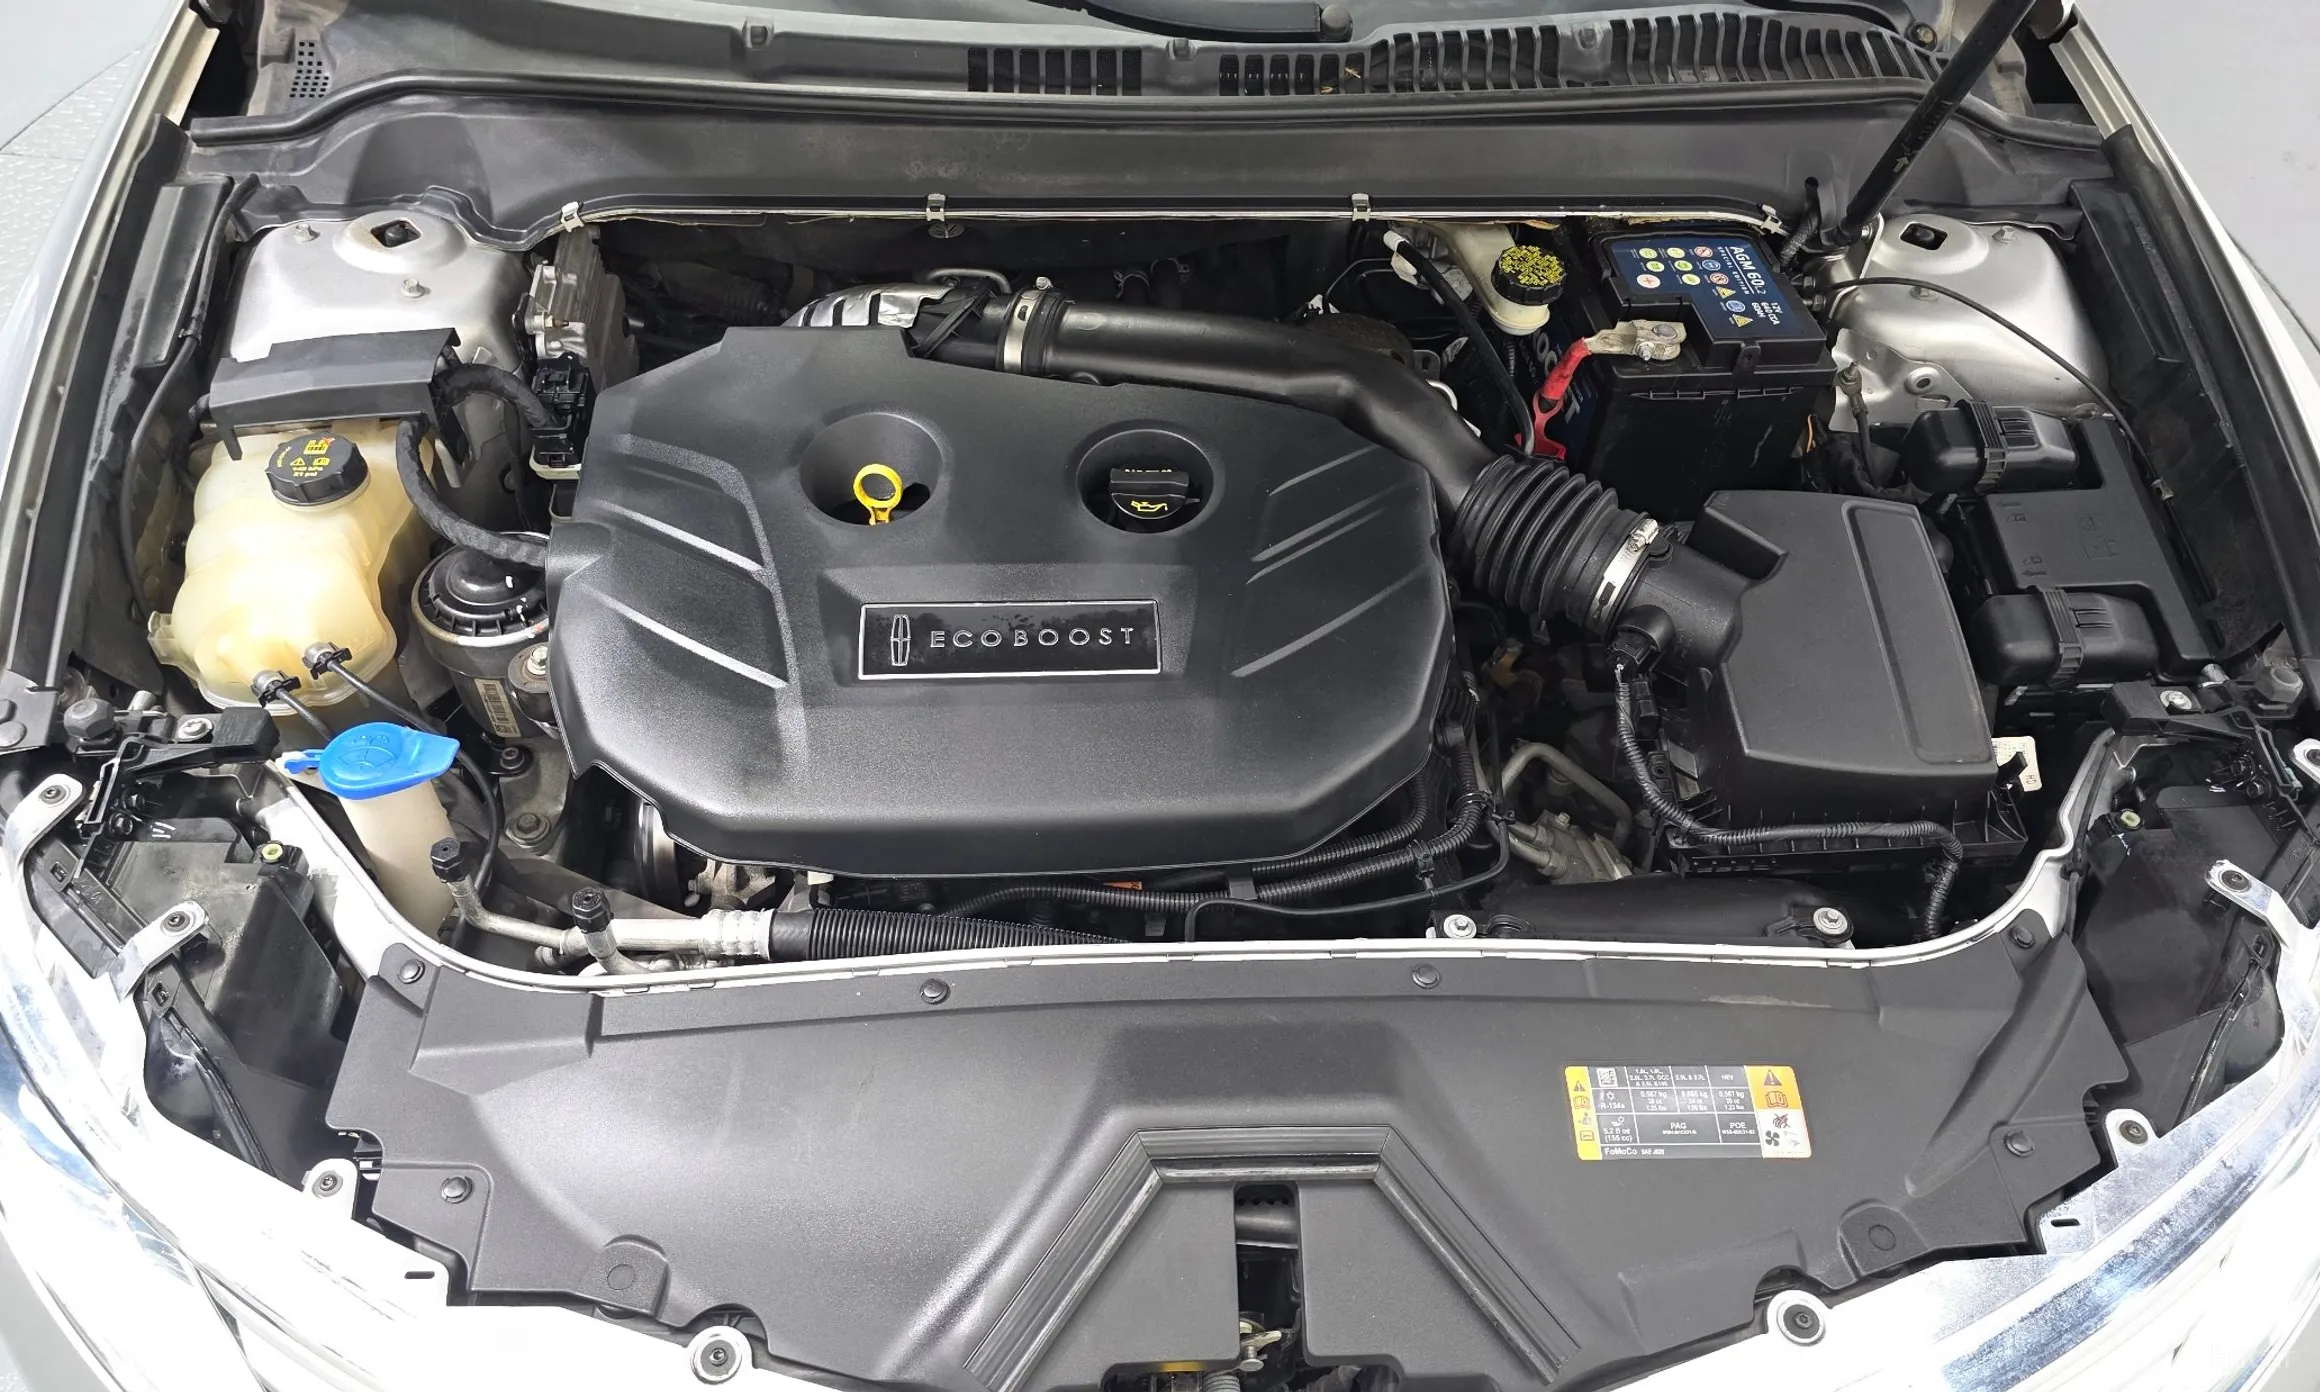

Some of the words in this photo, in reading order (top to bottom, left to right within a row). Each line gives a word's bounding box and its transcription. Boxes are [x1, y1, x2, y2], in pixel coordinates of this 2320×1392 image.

[1730, 246, 1756, 270] AGM
[929, 627, 1134, 648] ECOBOOST
[1604, 1147, 1638, 1155] FoMoCo
